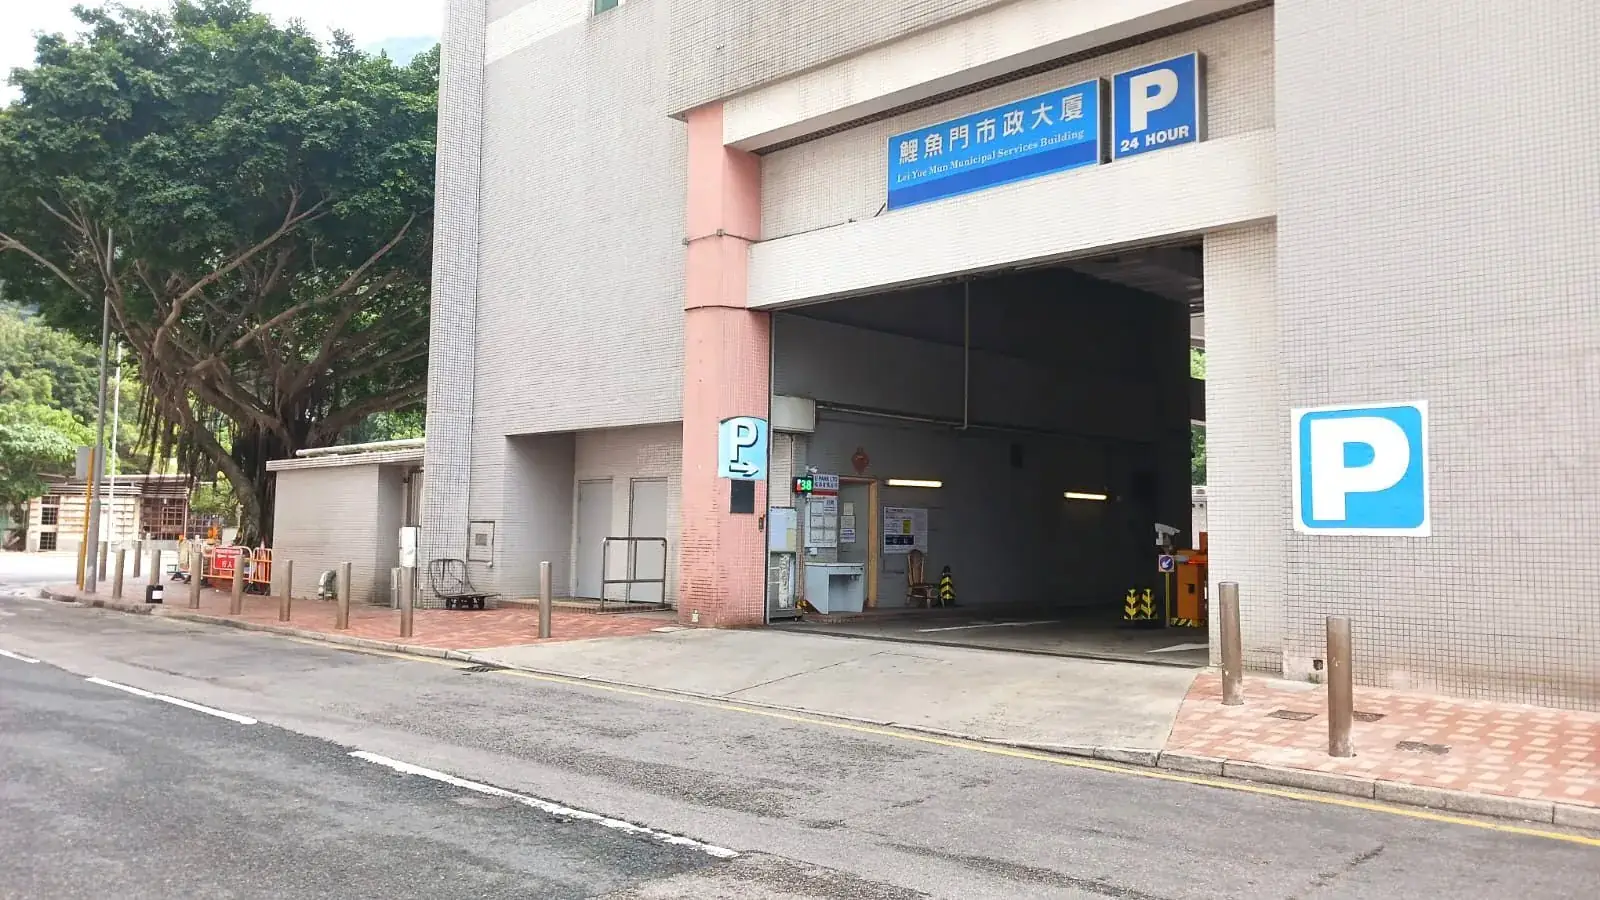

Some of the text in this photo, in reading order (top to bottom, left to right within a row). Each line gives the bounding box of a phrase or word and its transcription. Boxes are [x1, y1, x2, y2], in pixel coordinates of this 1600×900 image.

[899, 93, 1083, 165] 鯉魚門市政大廈
[1129, 68, 1179, 134] P
[897, 129, 1084, 182] Lei Yue Mun Municipal Services Building
[1120, 125, 1190, 153] 24 HOUR
[730, 417, 759, 463] P
[1310, 416, 1410, 521] P
